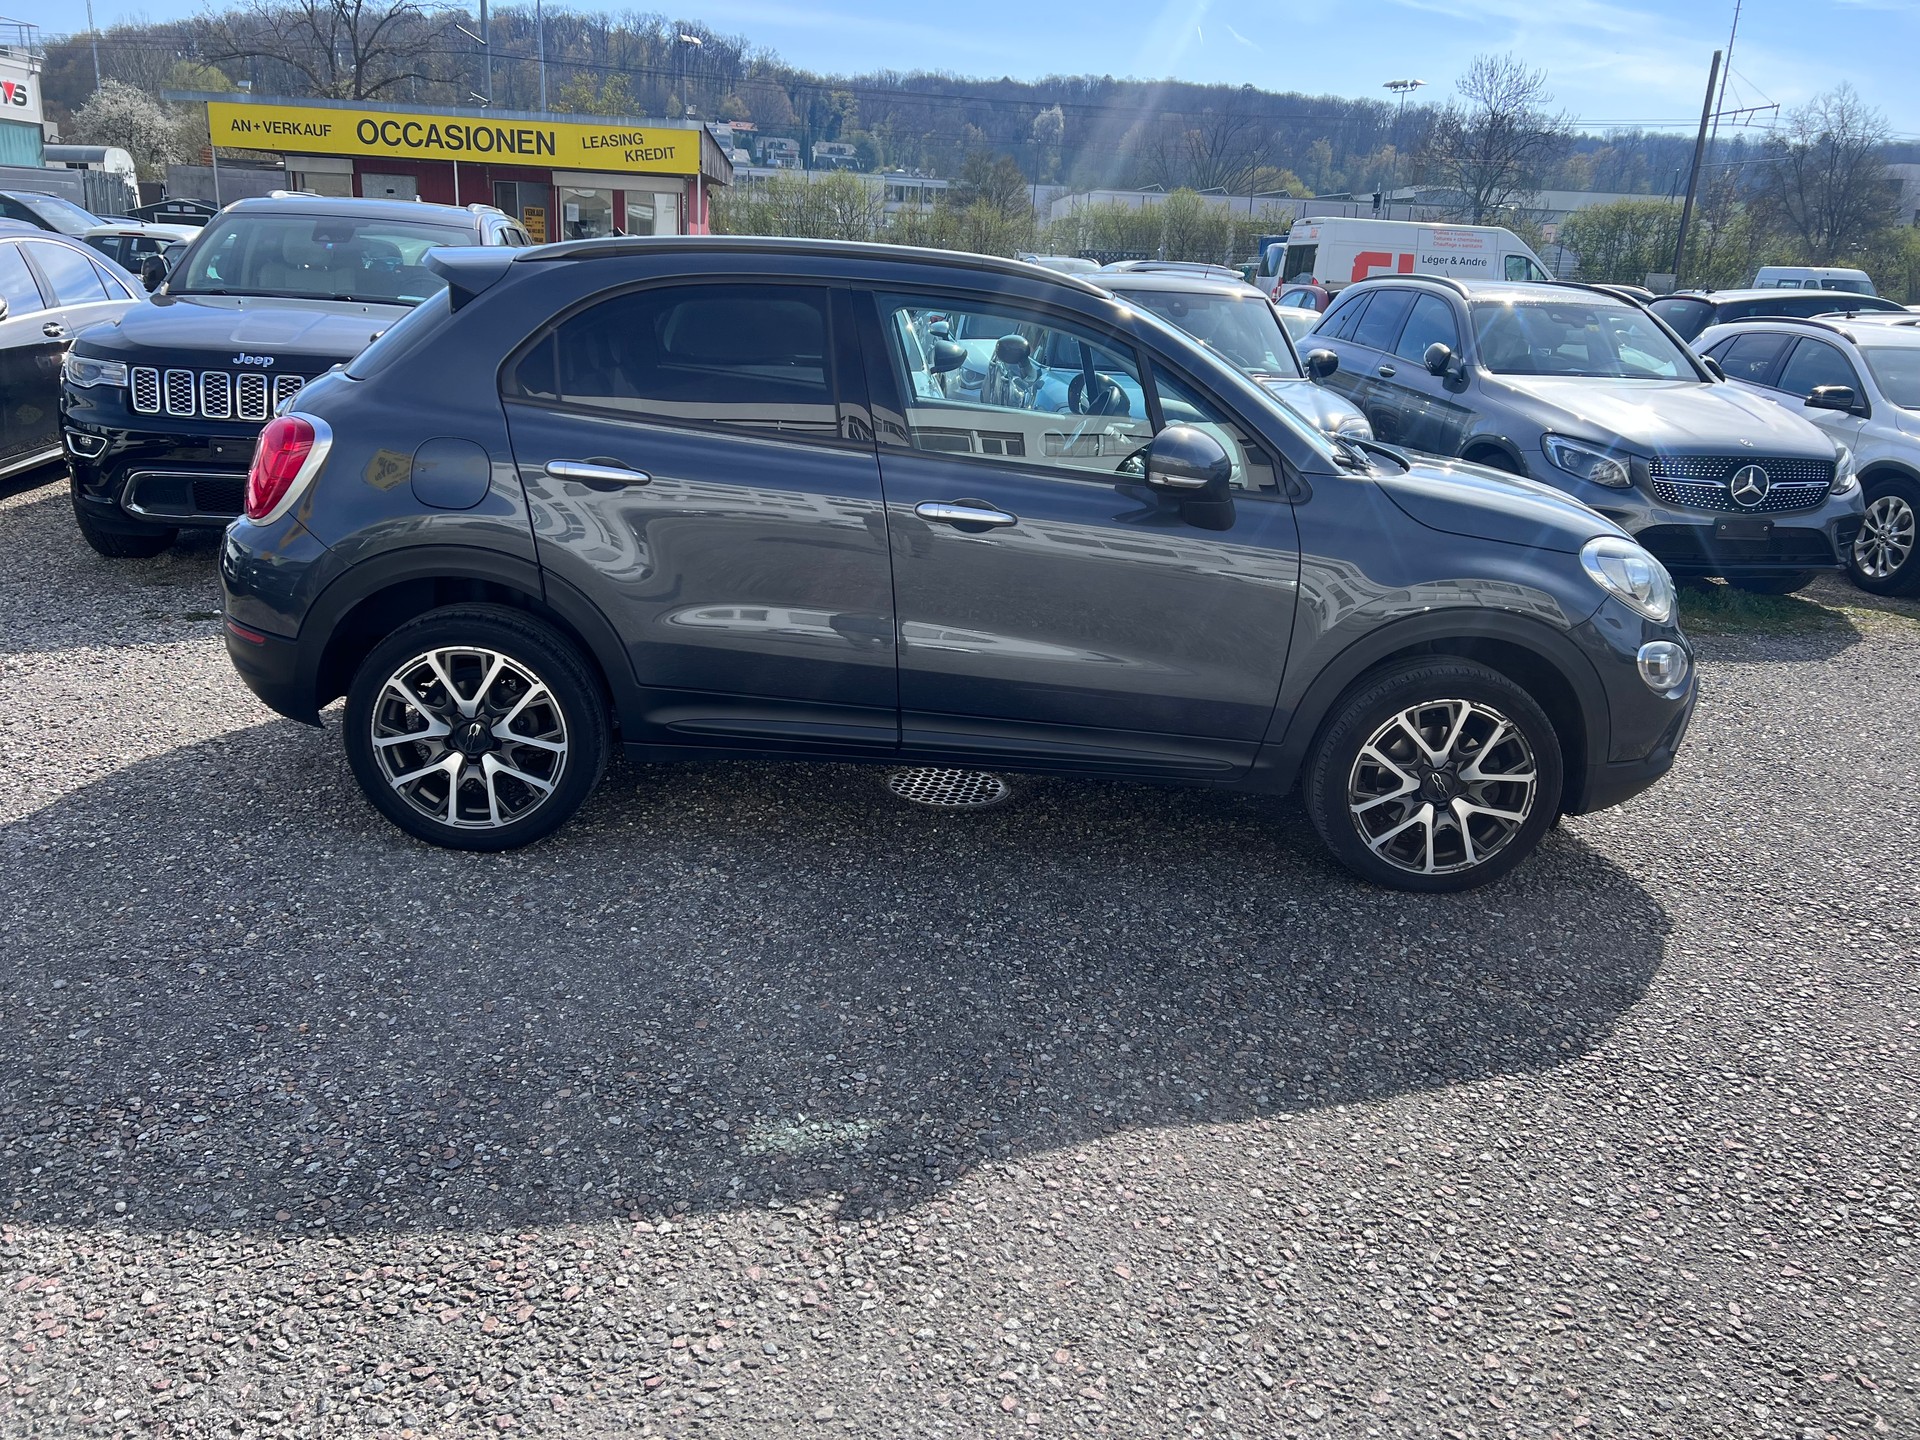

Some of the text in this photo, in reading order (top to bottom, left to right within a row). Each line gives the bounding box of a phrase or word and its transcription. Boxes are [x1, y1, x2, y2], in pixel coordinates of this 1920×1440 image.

[262, 120, 332, 137] VERKAUF
[356, 118, 556, 156] OCCASIONEN
[581, 132, 644, 149] LEASING
[624, 146, 676, 162] KREDIT
[1422, 254, 1487, 266] Léger & André
[232, 352, 275, 368] Jeep
